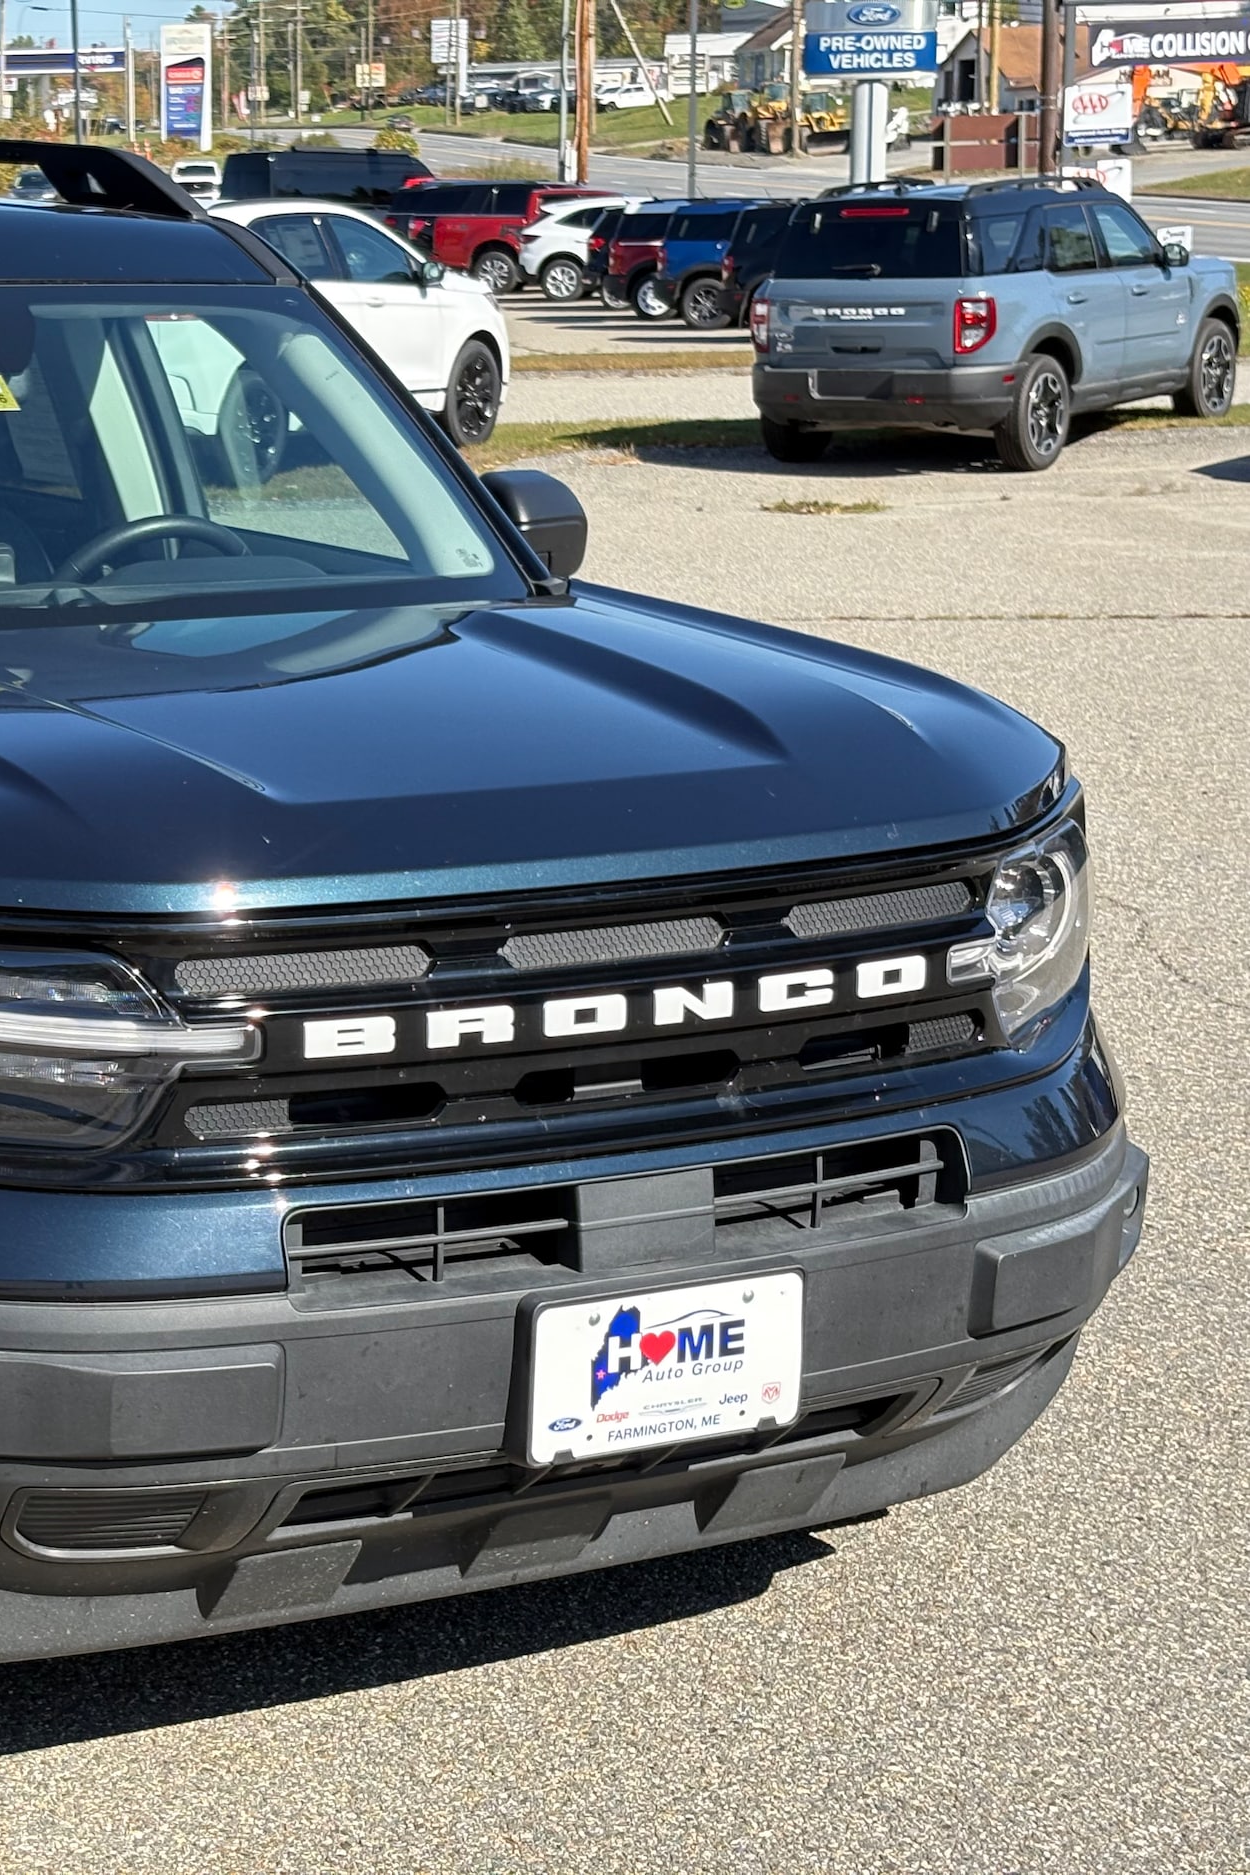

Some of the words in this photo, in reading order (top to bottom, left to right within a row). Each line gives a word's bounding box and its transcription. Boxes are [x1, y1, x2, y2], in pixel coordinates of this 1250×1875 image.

[858, 7, 893, 22] Ford
[819, 35, 927, 52] PRE-OWNED
[1151, 30, 1246, 58] COLLISION
[829, 53, 917, 69] VEHICLES
[812, 307, 906, 316] BRONCO
[302, 955, 927, 1059] BRONCO
[642, 1367, 684, 1383] Auto
[692, 1360, 744, 1376] Group
[552, 1418, 578, 1431] Ford
[596, 1411, 630, 1424] Dodge
[643, 1397, 703, 1410] CHRYSLER
[719, 1393, 748, 1405] Jeep
[608, 1418, 697, 1442] FARMINGTON,
[701, 1414, 721, 1427] ME
